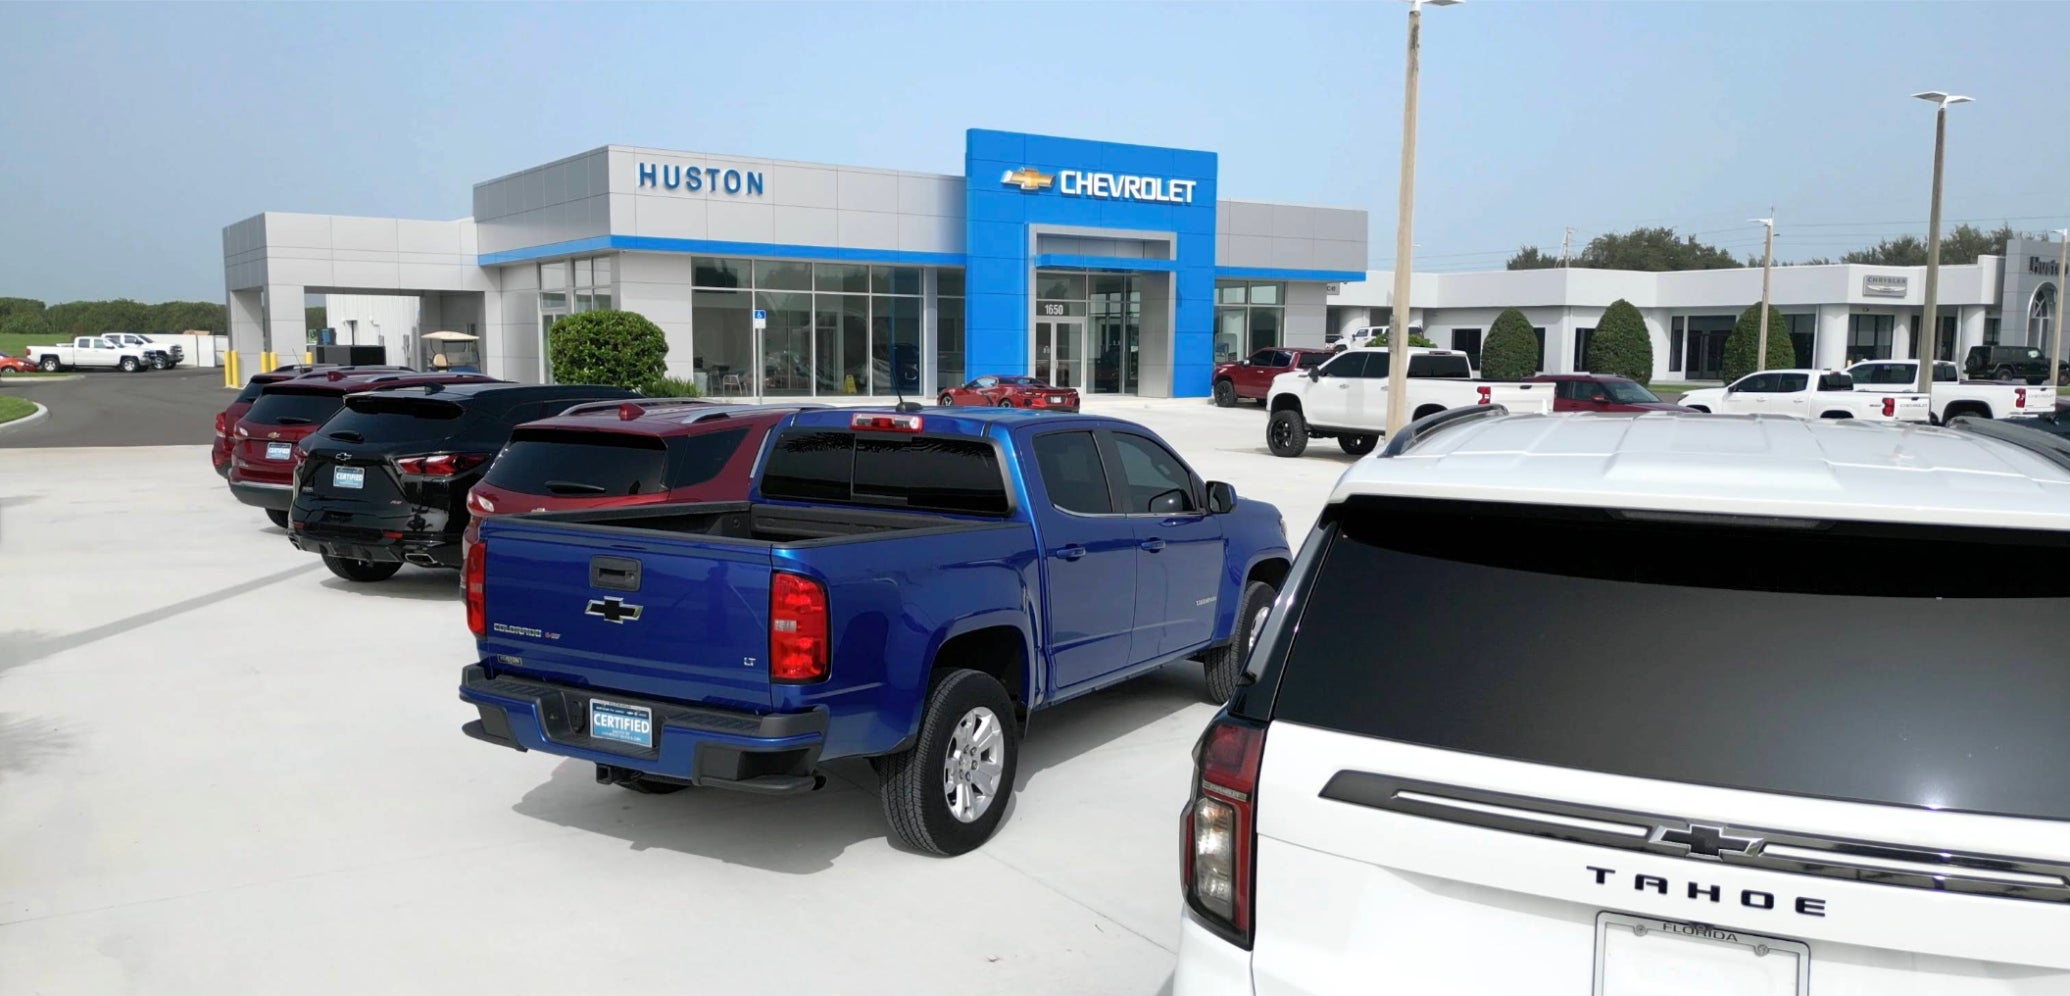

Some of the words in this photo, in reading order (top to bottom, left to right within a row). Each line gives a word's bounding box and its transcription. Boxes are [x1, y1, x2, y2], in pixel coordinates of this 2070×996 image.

[639, 162, 763, 195] HUSTON
[1060, 170, 1197, 203] CHEVROLET
[1044, 304, 1064, 315] 1650
[743, 657, 756, 667] LT
[594, 713, 650, 735] CERTIFIED
[1586, 865, 1826, 917] TAHOE
[1662, 922, 1738, 942] FLORIDA
